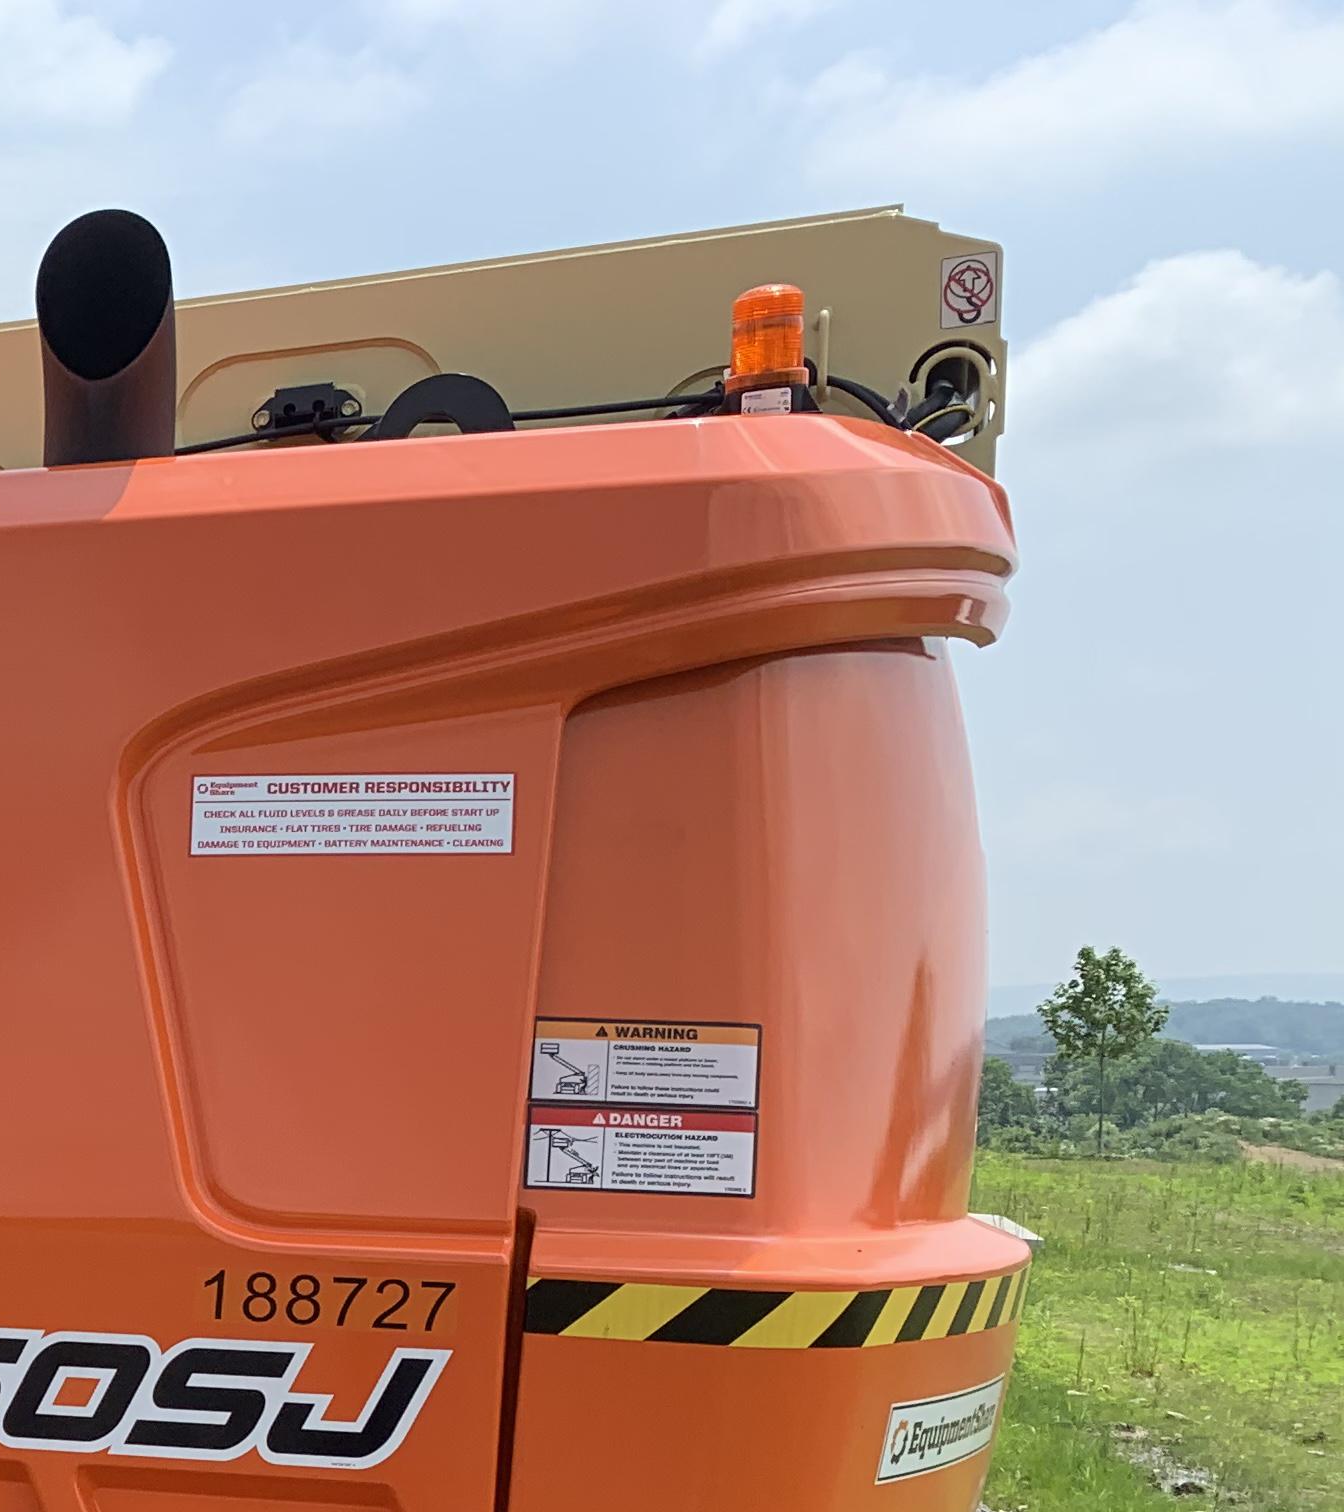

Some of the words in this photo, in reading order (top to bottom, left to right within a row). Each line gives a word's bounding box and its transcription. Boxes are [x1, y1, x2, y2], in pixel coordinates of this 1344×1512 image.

[267, 782, 360, 794] CUSTOMER
[364, 781, 511, 793] RESPONSIBILITY
[204, 810, 236, 818] CHECK
[239, 810, 255, 818] ALL
[258, 810, 288, 818] FLUID
[290, 809, 325, 818] LEVELS
[378, 809, 408, 817] DAILY
[410, 809, 449, 817] BEFORE
[451, 808, 484, 817] START
[486, 808, 500, 816] UP
[219, 825, 278, 834] INSURANCE
[285, 824, 309, 833] FLAT
[311, 824, 340, 833] TIRES
[348, 824, 372, 832] TIRE
[375, 824, 418, 832] DAMAGE
[426, 824, 482, 832] REFUELING
[198, 840, 240, 849] DAMAGE
[242, 840, 255, 848] TO
[257, 840, 316, 850] EQUIPMENT
[324, 840, 368, 848] BATTERY
[370, 839, 444, 848] MAINTENANCE
[453, 839, 504, 848] CLEANING
[615, 1026, 698, 1040] WARNING
[609, 1113, 682, 1128] DANGER
[615, 1132, 682, 1140] ELECTROCUTION
[684, 1134, 718, 1142] HAZARD
[202, 1268, 458, 1333] 188727
